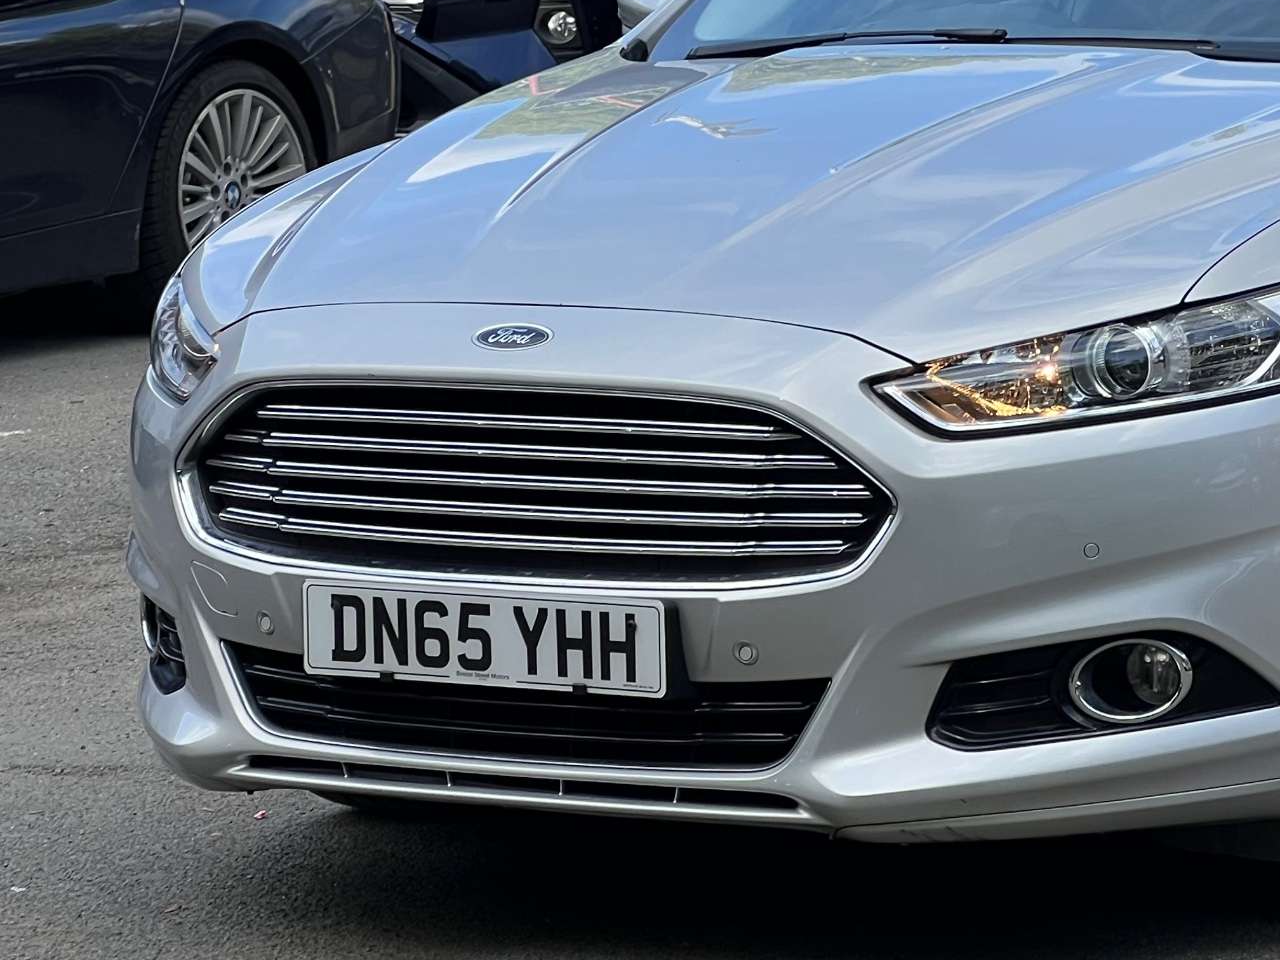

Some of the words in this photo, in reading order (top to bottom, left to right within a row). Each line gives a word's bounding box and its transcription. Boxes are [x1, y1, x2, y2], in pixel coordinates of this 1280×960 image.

[487, 327, 536, 344] Ford
[331, 593, 492, 672] DN65
[512, 605, 636, 683] YHH
